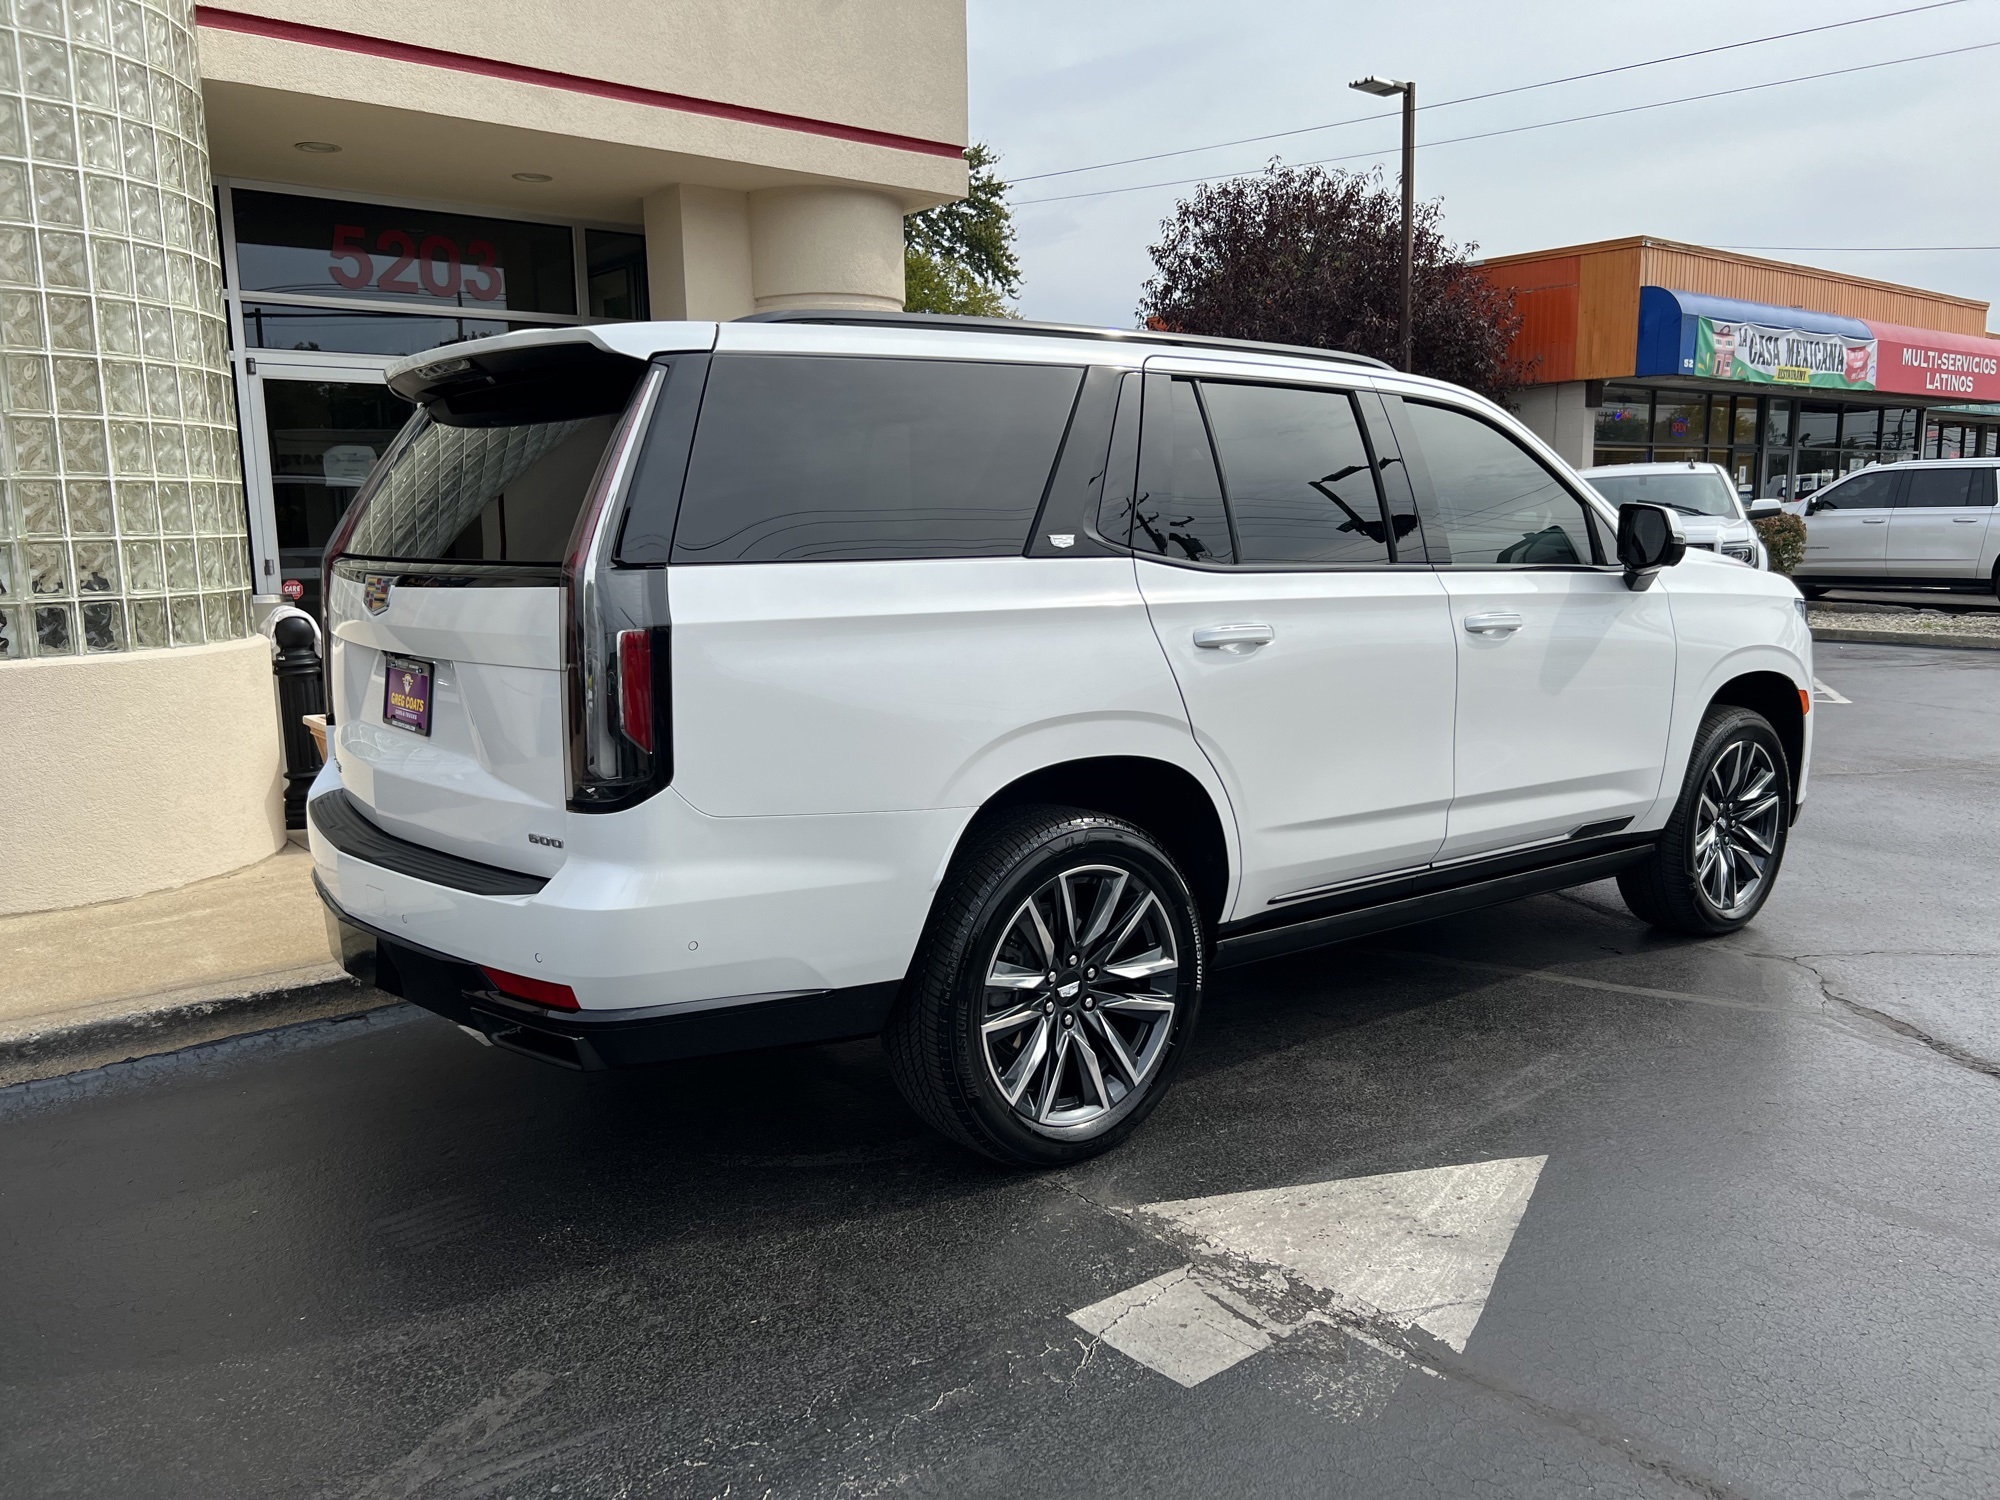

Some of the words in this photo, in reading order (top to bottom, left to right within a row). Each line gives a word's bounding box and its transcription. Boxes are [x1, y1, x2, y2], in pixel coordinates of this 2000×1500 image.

[329, 224, 502, 301] 5203
[1738, 328, 1748, 348] LA
[1748, 333, 1780, 366] CASA
[1785, 338, 1845, 372] MEXICANA
[1902, 348, 1997, 375] MULTI-SERVICIOS
[1926, 372, 1974, 392] LATINOS
[1672, 422, 1687, 433] OPEN
[391, 692, 405, 707] GREG
[405, 696, 425, 712] COATS
[528, 833, 564, 849] 600
[1186, 906, 1203, 991] BRIDGESTONE
[956, 999, 980, 1098] BRIDGESTONE
